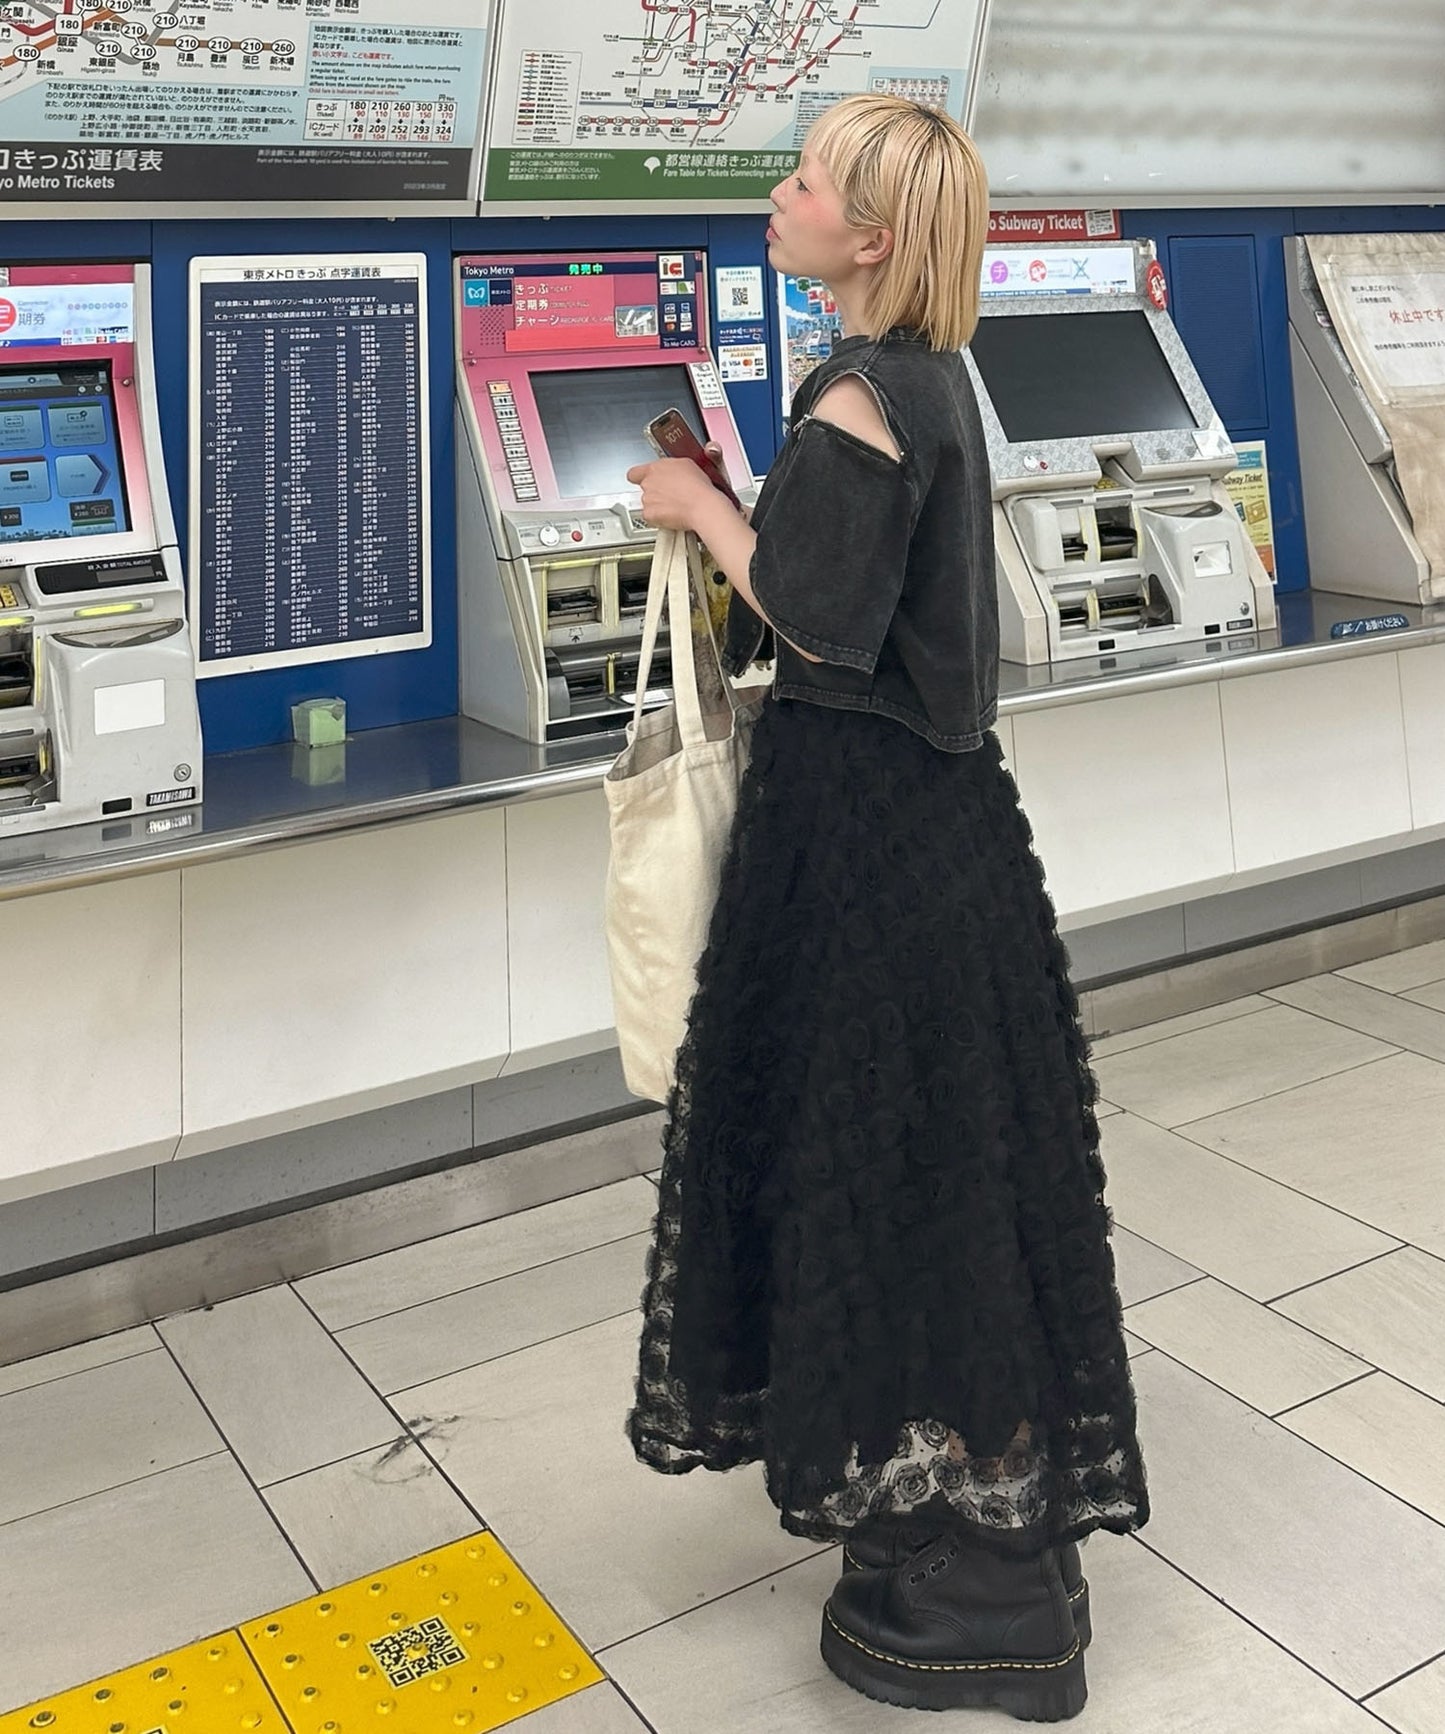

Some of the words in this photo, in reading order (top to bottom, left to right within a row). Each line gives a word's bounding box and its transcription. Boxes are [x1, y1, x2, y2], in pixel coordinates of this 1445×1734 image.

[110, 0, 128, 9] 210
[60, 20, 79, 29] 180
[156, 16, 174, 25] 210
[180, 15, 206, 25] 八丁堀
[124, 26, 143, 34] 210
[100, 44, 118, 53] 210
[179, 40, 196, 48] 210
[211, 40, 229, 49] 210
[243, 42, 260, 50] 210
[275, 44, 292, 52] 260
[18, 49, 36, 58] 180
[134, 48, 152, 56] 210
[350, 102, 366, 110] 180
[372, 102, 388, 110] 210
[394, 102, 410, 110] 260
[416, 103, 432, 111] 300
[309, 122, 340, 131] ICカード
[347, 124, 363, 132] 178
[369, 125, 386, 133] 209
[666, 154, 796, 167] 都営線連絡きっぷ運賃表
[730, 170, 764, 178] Connecting
[18, 175, 60, 189] Metro
[64, 175, 116, 189] Tickets
[999, 215, 1046, 234] Subway
[1047, 214, 1083, 230] Ticket
[243, 270, 294, 280] 東京メトロ
[297, 268, 327, 279] きっぷ
[331, 267, 381, 278] 点字運賃表
[464, 266, 488, 277] Tokyo
[490, 266, 514, 275] Metro
[569, 264, 603, 275] 発売中
[514, 283, 549, 296] きっぷ
[515, 299, 549, 311] 定期券
[18, 312, 46, 326] 期券
[1389, 308, 1444, 324] 休止中です
[1244, 473, 1263, 482] Ticket
